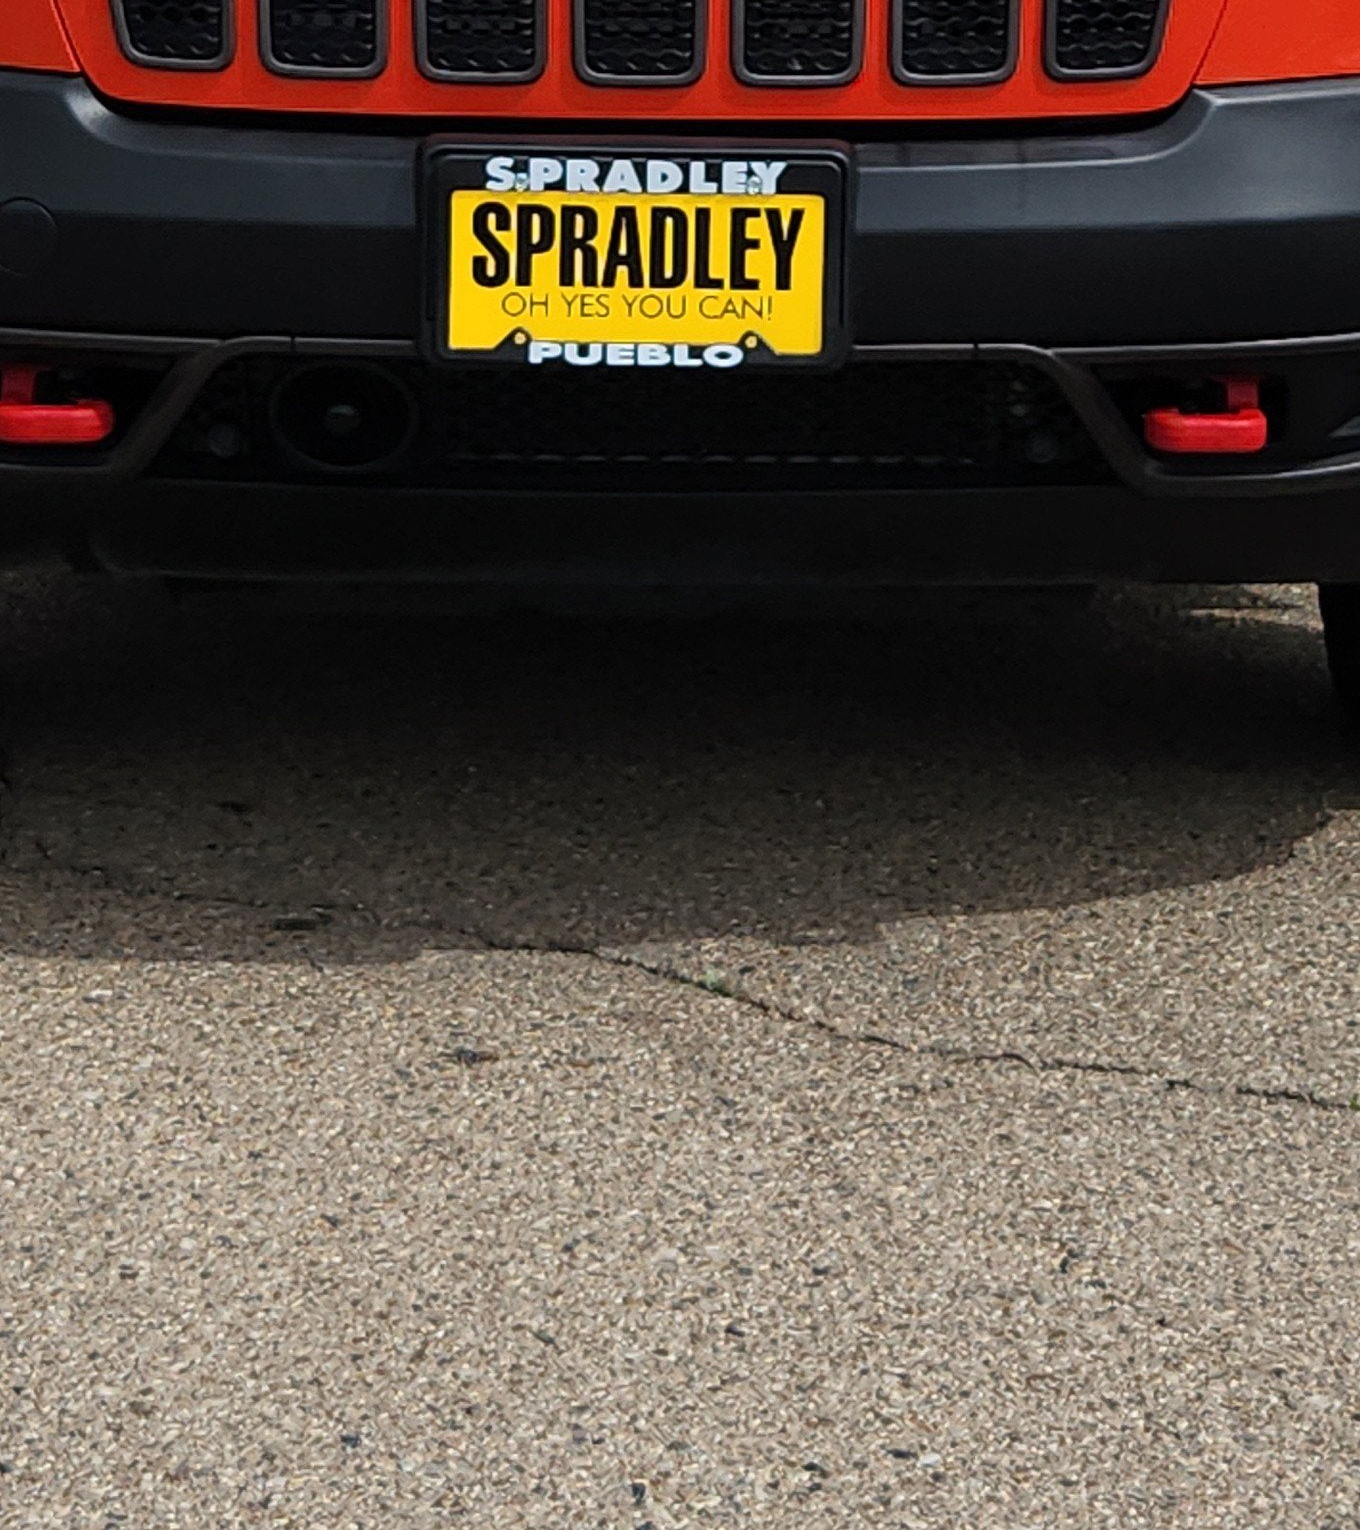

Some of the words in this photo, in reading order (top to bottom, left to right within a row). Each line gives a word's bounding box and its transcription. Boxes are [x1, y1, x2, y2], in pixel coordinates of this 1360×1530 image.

[485, 156, 787, 194] SPRADLEY
[471, 202, 805, 291] SPRADLEY
[501, 292, 549, 318] OH
[562, 294, 610, 318] YES
[621, 295, 687, 319] YOU
[698, 295, 773, 321] CAN!
[528, 343, 744, 368] PUEBLO
